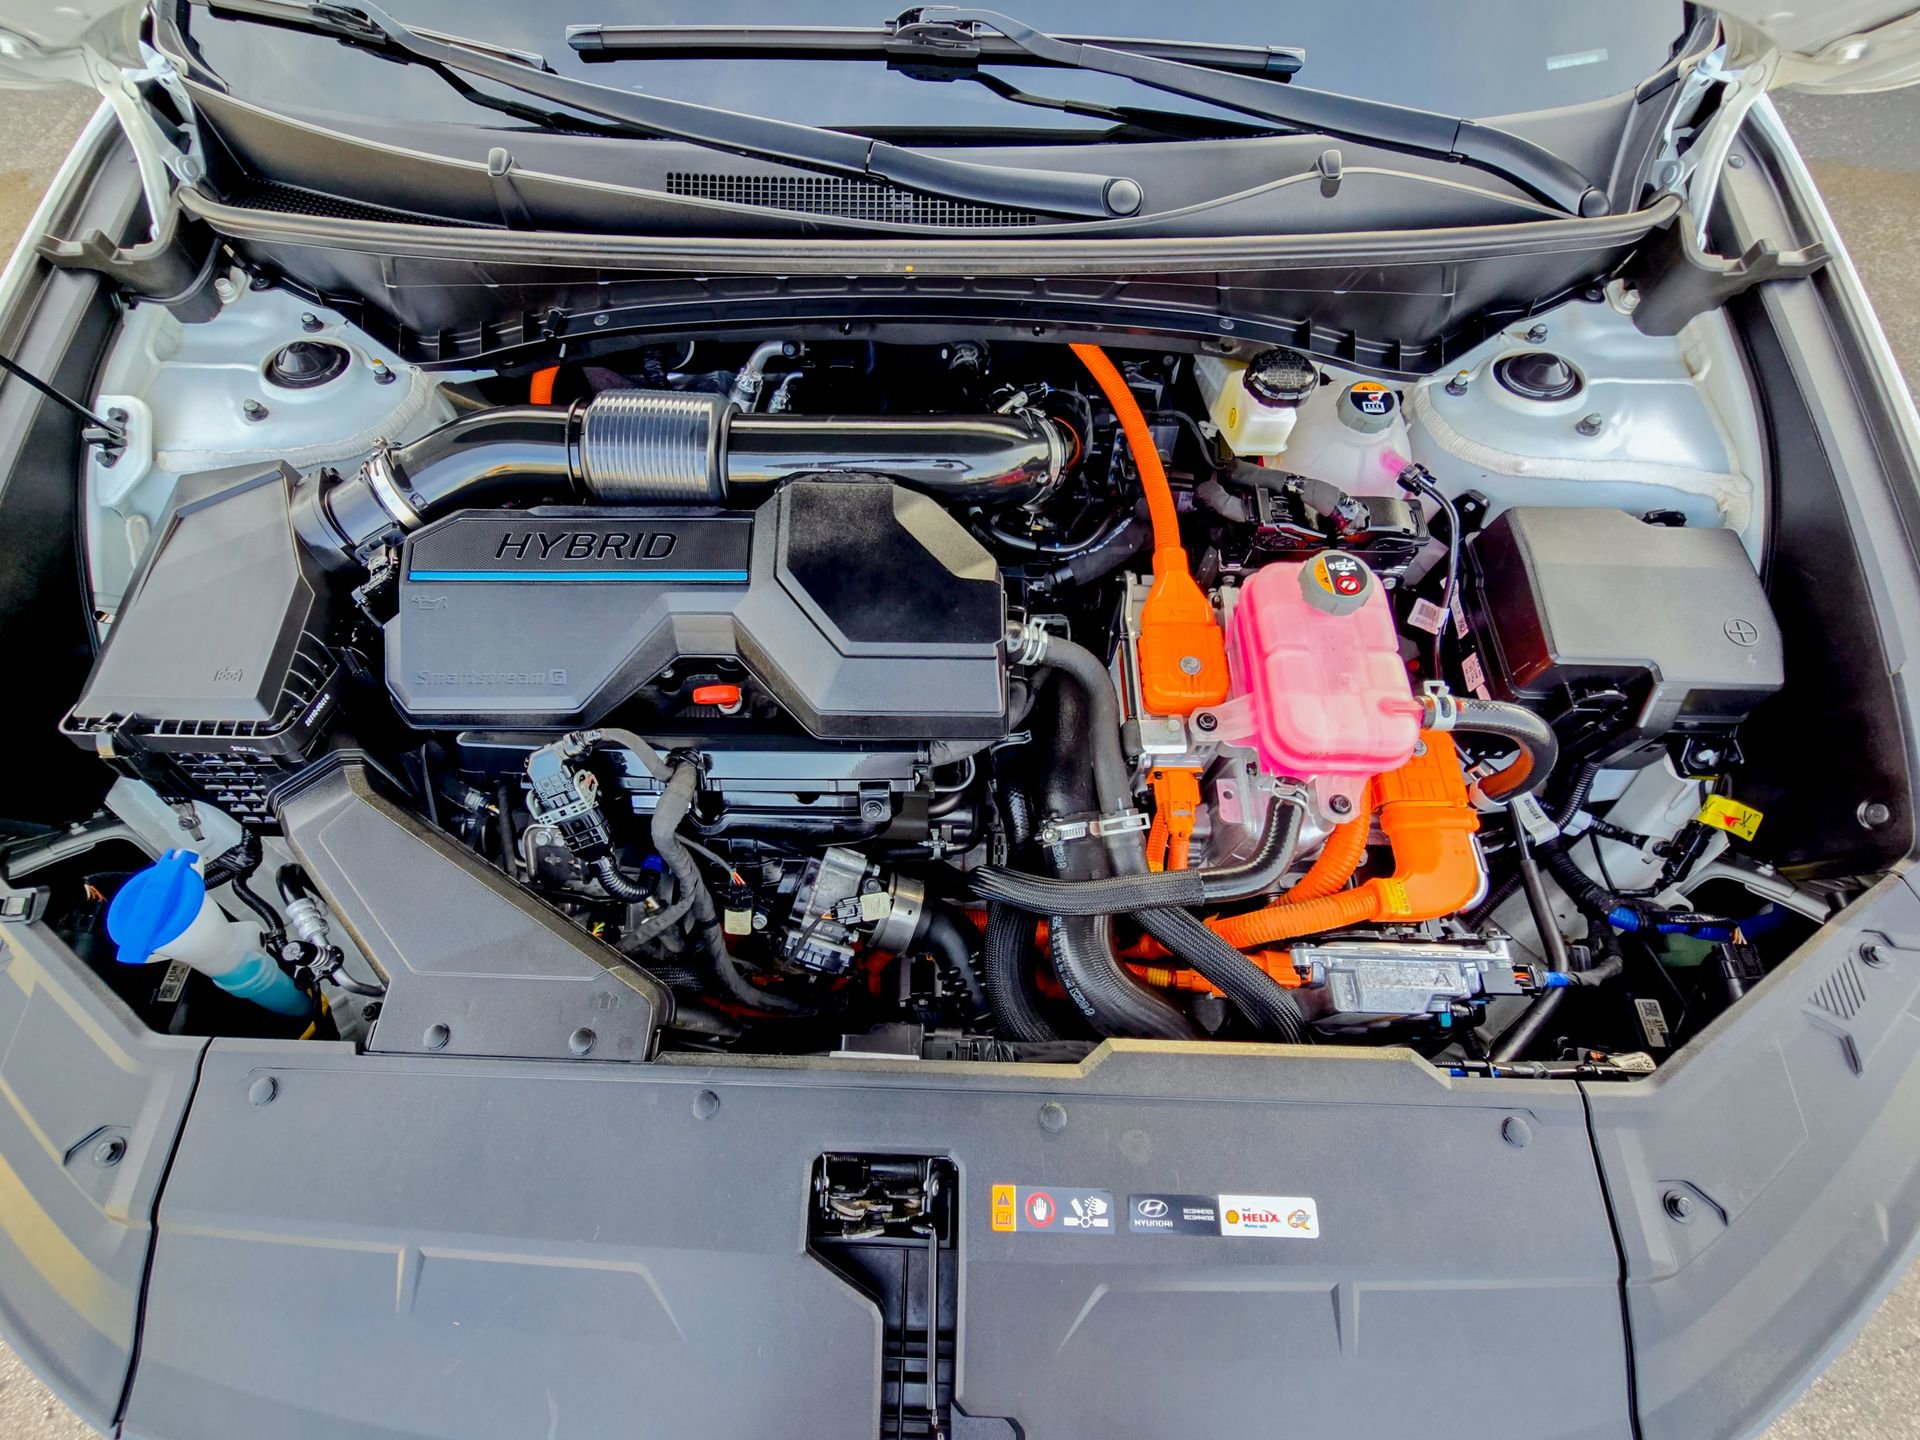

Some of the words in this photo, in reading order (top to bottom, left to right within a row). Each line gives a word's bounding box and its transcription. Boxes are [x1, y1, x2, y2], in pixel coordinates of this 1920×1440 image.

[495, 532, 678, 560] HYBRID
[414, 669, 546, 686] Smartstream
[1134, 1219, 1173, 1228] HYUNDAI
[1242, 1212, 1279, 1223] HELIX
